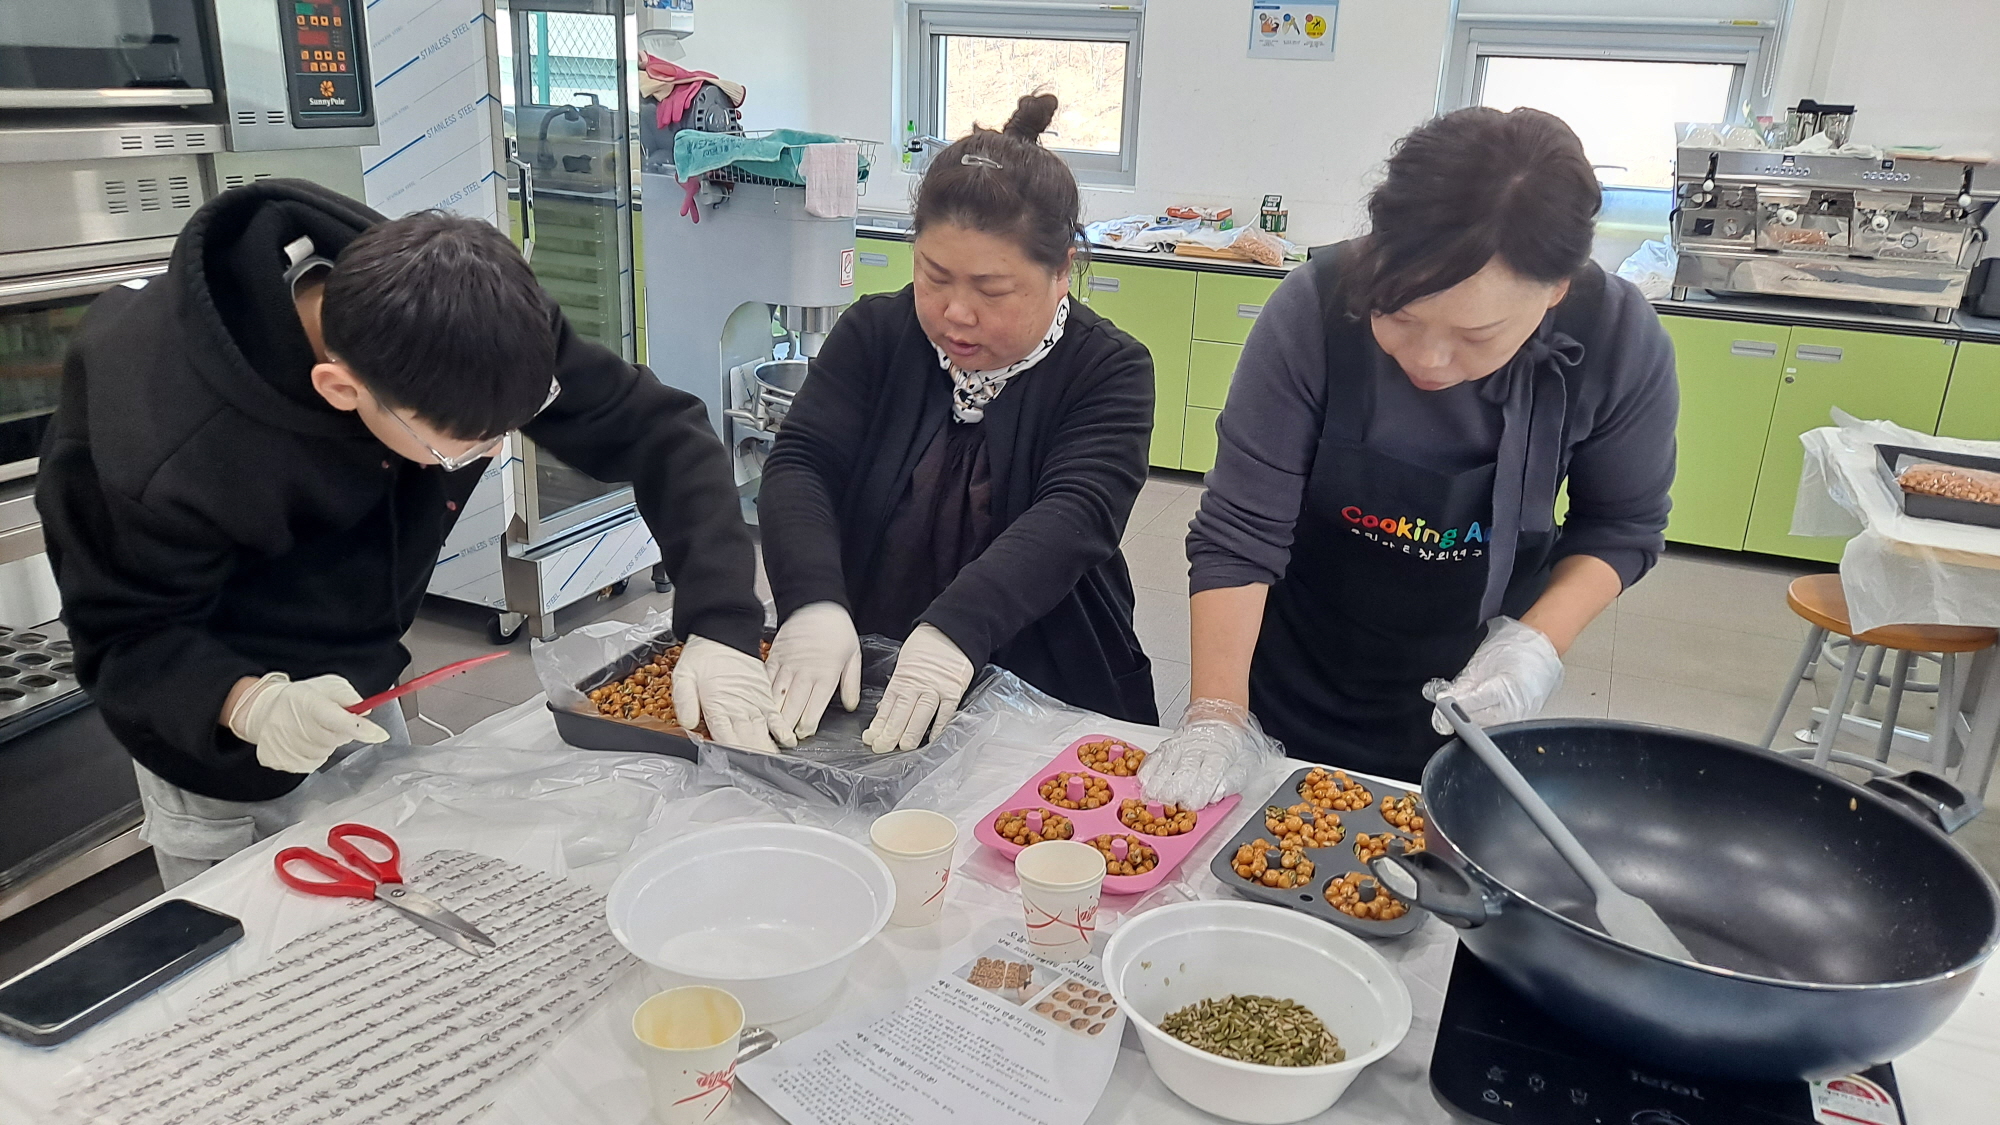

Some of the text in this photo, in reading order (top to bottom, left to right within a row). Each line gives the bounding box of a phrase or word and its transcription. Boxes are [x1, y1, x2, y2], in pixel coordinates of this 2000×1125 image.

[419, 22, 470, 60] STAINLESS STEEL
[308, 97, 346, 107] SunnyPole
[426, 103, 476, 139] STAINLESS STEEL
[462, 180, 482, 199] STEEL
[483, 468, 501, 481] STEEL
[1341, 505, 1459, 549] Cooking
[460, 540, 487, 557] STAINLESS
[634, 545, 648, 561] STEEL
[545, 593, 561, 610] STEEL
[1001, 1008, 1023, 1025] 만들기
[892, 1055, 914, 1071] 만들기
